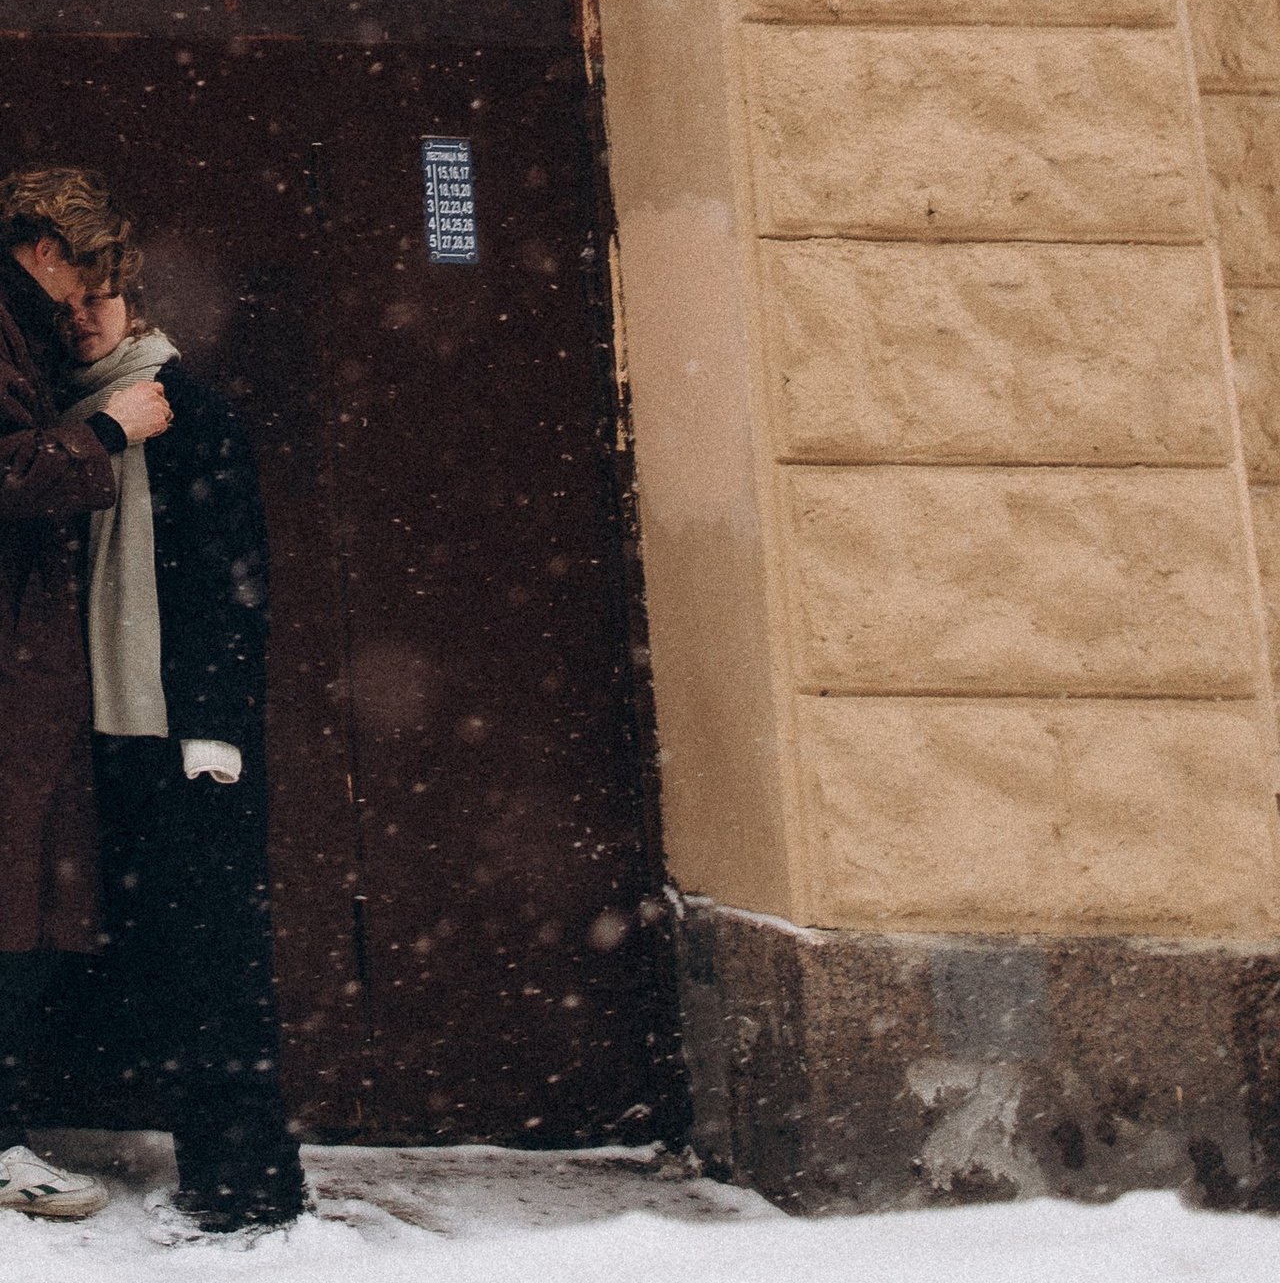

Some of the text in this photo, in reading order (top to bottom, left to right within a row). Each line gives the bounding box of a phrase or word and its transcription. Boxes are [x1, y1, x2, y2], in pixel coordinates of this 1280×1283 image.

[425, 165, 469, 181] 1 15,16,17
[426, 182, 434, 195] 2
[427, 199, 434, 212] 3
[428, 217, 436, 230] 4
[429, 234, 437, 247] 5
